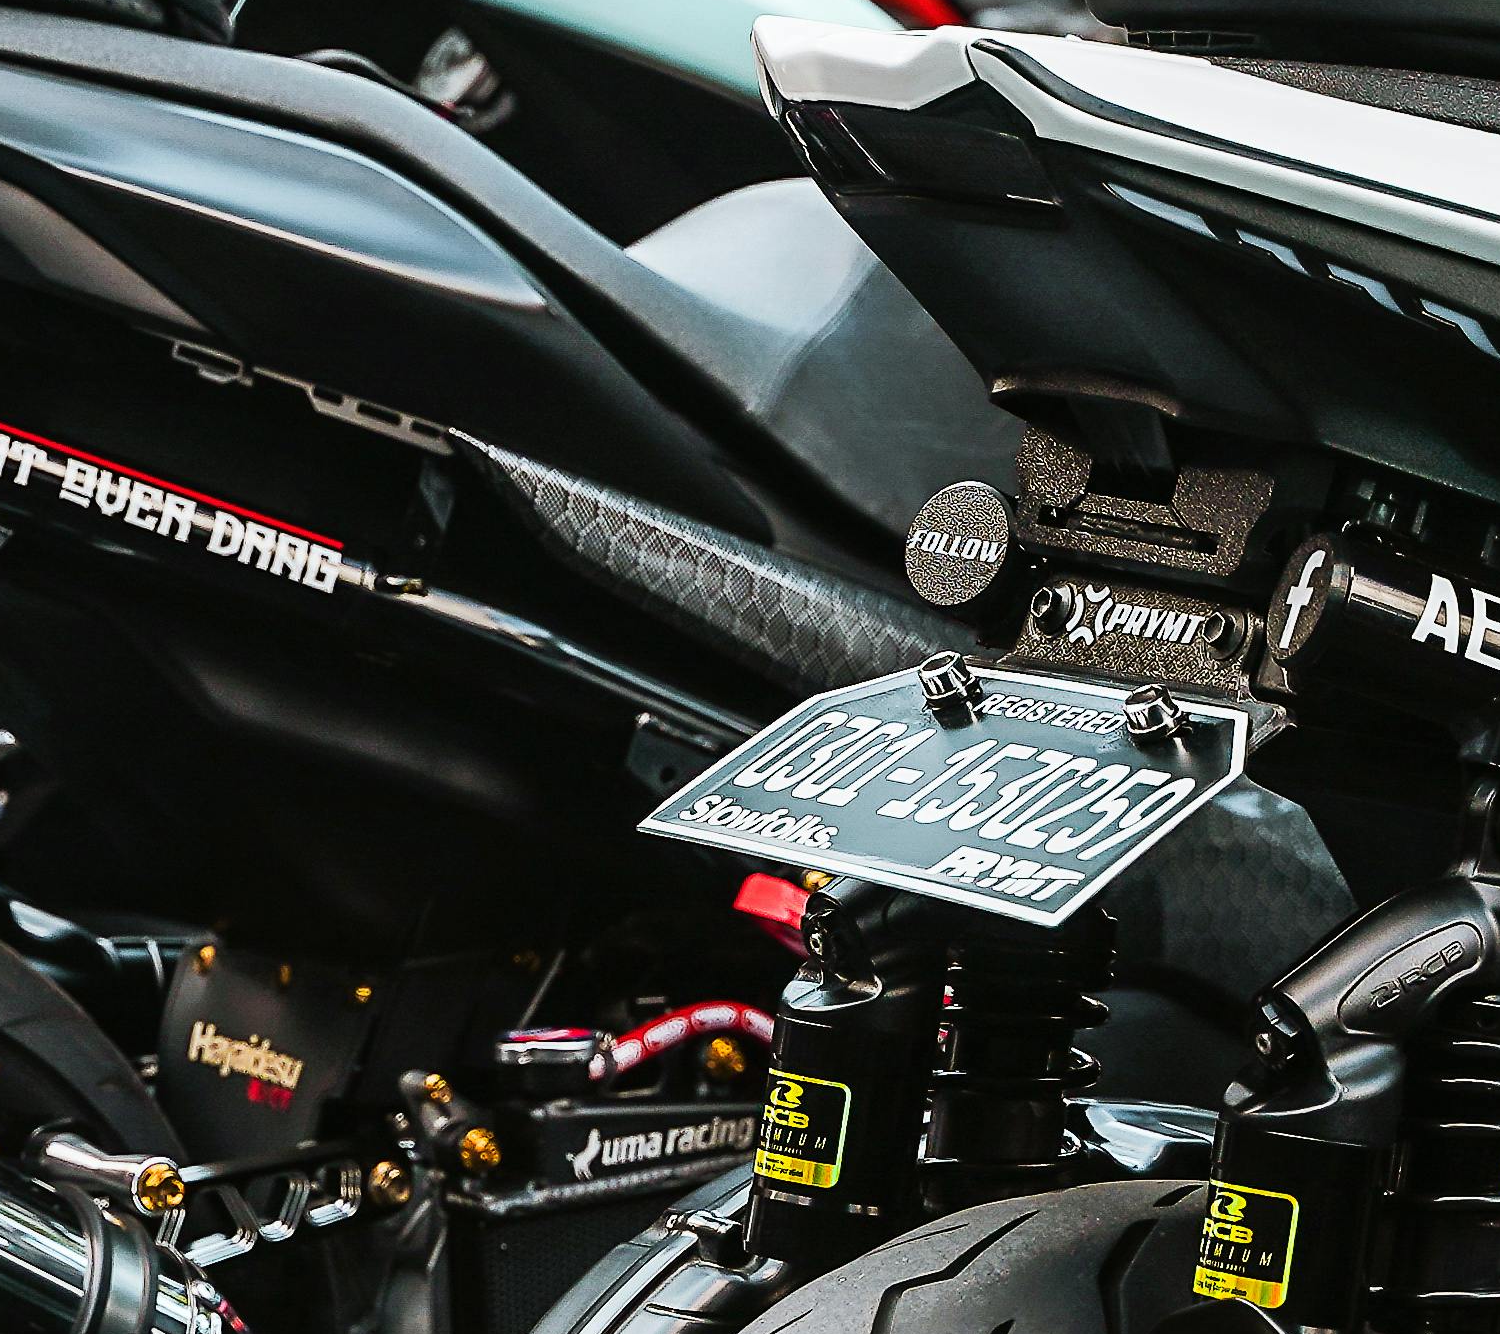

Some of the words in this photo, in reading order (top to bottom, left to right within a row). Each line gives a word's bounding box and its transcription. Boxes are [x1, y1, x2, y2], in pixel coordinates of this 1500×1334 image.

[907, 529, 1007, 563] FOLLOW
[1105, 604, 1205, 644] PRYMT
[974, 692, 1127, 736] REGISTERED
[928, 844, 1086, 903] PRYMT
[763, 1104, 810, 1129] RCB
[1202, 1217, 1254, 1245] RCB
